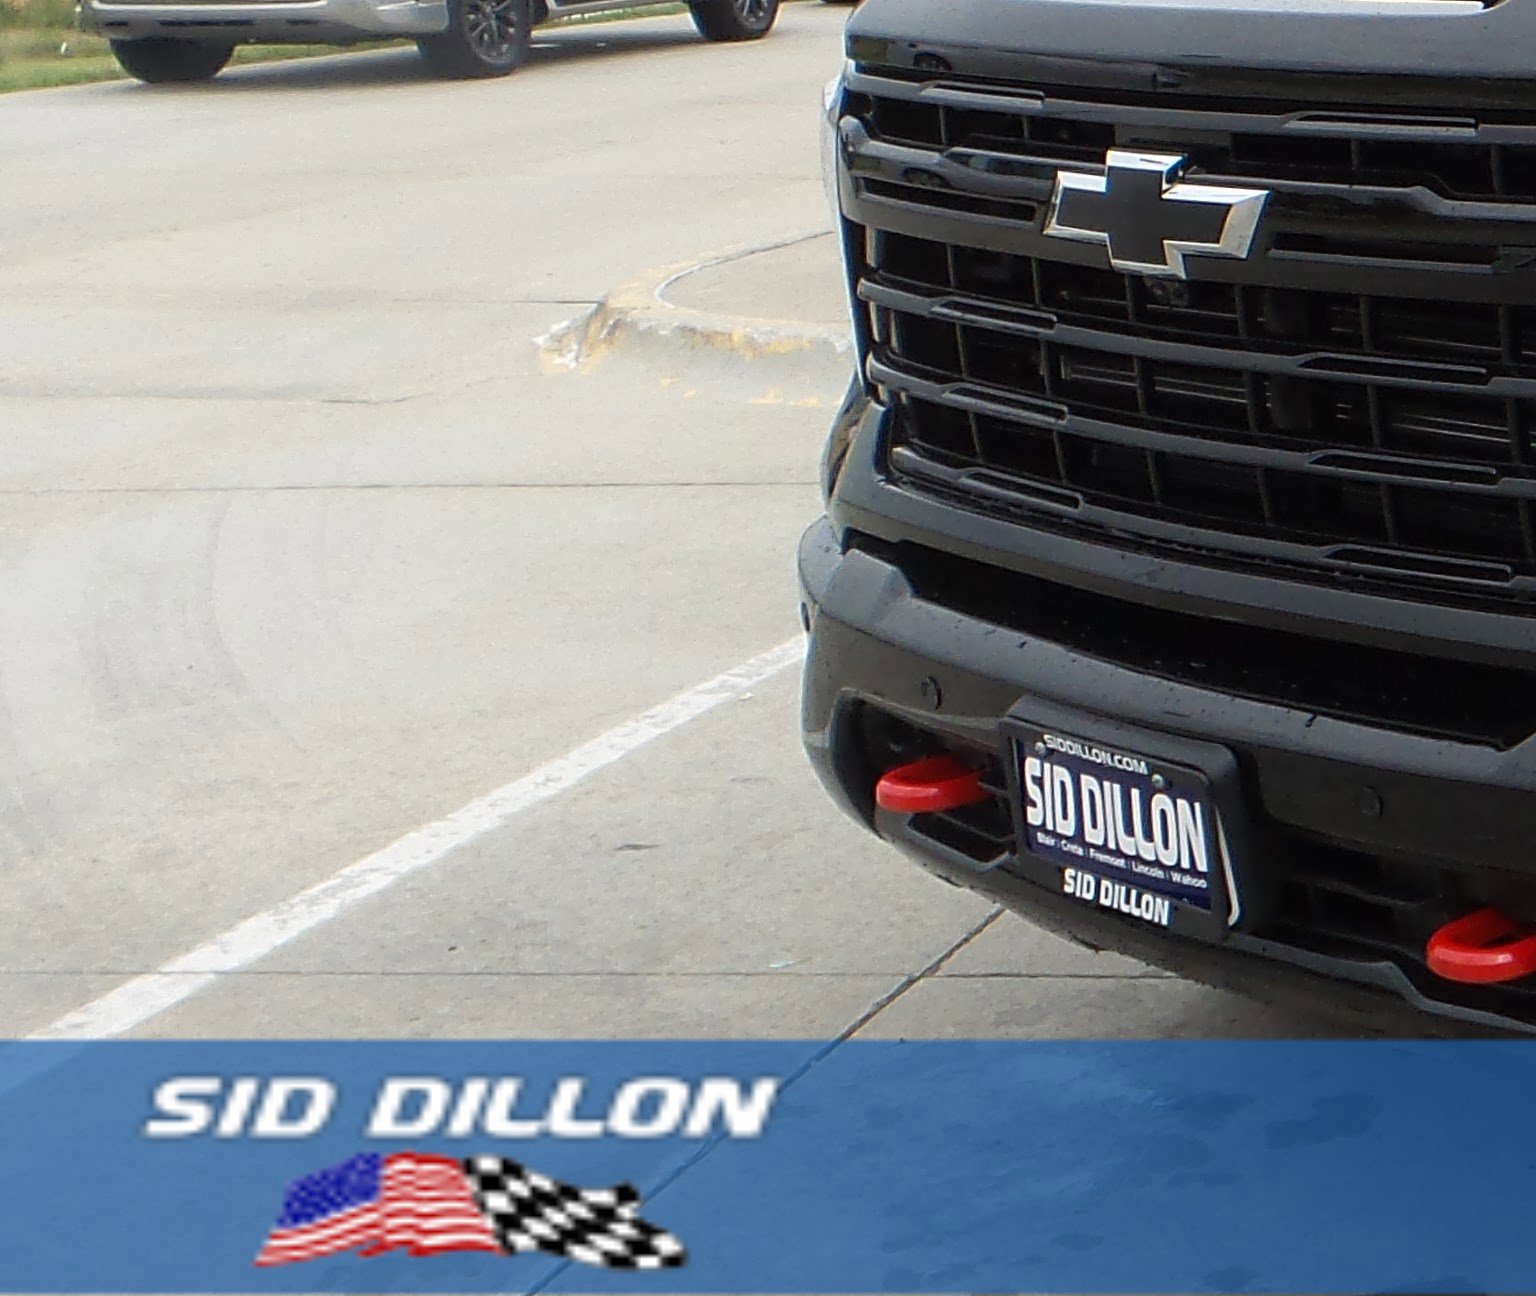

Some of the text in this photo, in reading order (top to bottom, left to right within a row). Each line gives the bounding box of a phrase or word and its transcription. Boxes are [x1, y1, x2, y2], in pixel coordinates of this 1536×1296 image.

[1043, 734, 1148, 776] SIDDILLON.COM
[1024, 757, 1208, 872] SID DILLON
[1063, 868, 1170, 926] SID DILLON
